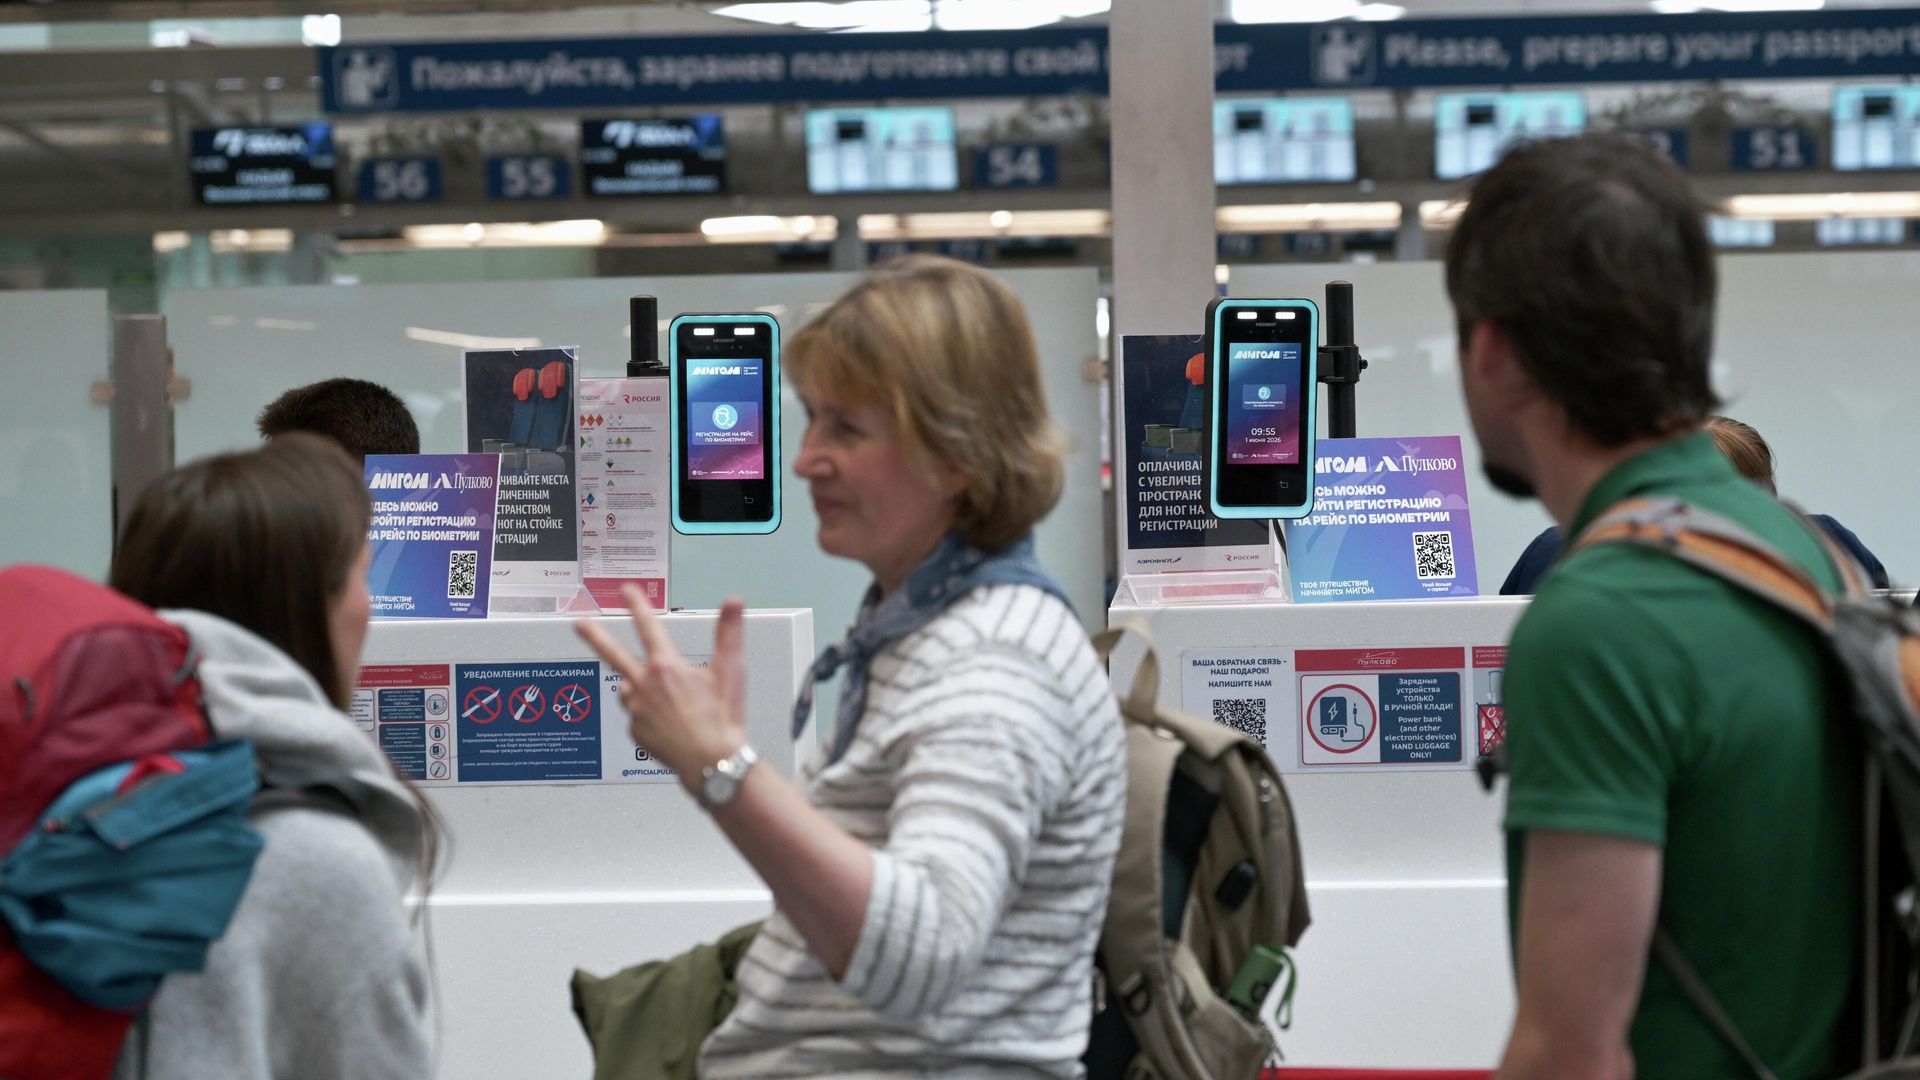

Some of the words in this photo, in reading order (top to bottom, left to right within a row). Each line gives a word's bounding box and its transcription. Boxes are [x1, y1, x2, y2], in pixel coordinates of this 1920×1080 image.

[1384, 33, 1511, 70] Please,
[1522, 35, 1669, 71] prepare
[1671, 32, 1759, 70] your
[411, 52, 634, 94] Пожалуйста,
[640, 54, 784, 90] заранее
[791, 47, 1008, 84] подготовьте
[1013, 41, 1096, 76] свой
[1751, 127, 1802, 169] 51
[988, 147, 1042, 185] 54
[373, 159, 428, 198] 56
[502, 158, 556, 197] 55
[1233, 350, 1280, 359] МИГОМ
[691, 366, 741, 375] МИГОМ
[1251, 427, 1276, 436] 09:55
[1138, 460, 1202, 472] ОПЛАЧИВА
[1315, 456, 1367, 473] ИГОМ
[1402, 455, 1457, 476] Пулково
[368, 472, 429, 489] МИГОМ
[454, 473, 493, 493] Пулково
[499, 473, 540, 485] ЧИВАЙТЕ
[541, 475, 569, 485] МЕСТА
[1138, 476, 1146, 487] С
[1333, 485, 1386, 496] МОЖНО
[371, 501, 399, 513] ДЕСЬ
[400, 501, 439, 512] МОЖНО
[496, 504, 551, 514] СТРАНСТВОМ
[1313, 498, 1344, 511] ЙТИ
[1345, 497, 1441, 511] РЕГИСТРАЦИЮ
[1139, 506, 1162, 518] ДЛЯ
[1165, 505, 1187, 516] НОГ
[1189, 505, 1205, 515] НА
[406, 515, 476, 528] РЕГИСТРАЦИЮ
[497, 519, 514, 529] НОГ
[516, 519, 528, 529] НА
[529, 516, 563, 529] СТОЙКЕ
[1313, 512, 1347, 525] РЕЙС
[1348, 514, 1367, 525] ПО
[1368, 512, 1450, 524] БИОМЕТРИИ
[1140, 519, 1218, 531] РЕГИСТРАЦИИ
[380, 528, 406, 540] РЕЙС
[407, 530, 420, 540] ПО
[421, 530, 480, 541] БИОМЕТРИИ
[495, 534, 538, 545] ИСТРАЦИИ
[1319, 580, 1368, 588] путешествие
[1300, 588, 1343, 596] начинается
[1345, 586, 1375, 595] МИГОМ
[393, 602, 415, 610] МИГОМ
[1192, 659, 1215, 667] ВАША
[1216, 658, 1256, 666] ОБРАТНАЯ
[464, 670, 530, 679] УВЕДОМЛЕНИЕ
[531, 669, 594, 678] ПАССАЖИРАМ
[1230, 667, 1269, 676] ПОДАРОК!
[1208, 680, 1252, 688] НАПИШИТЕ
[1399, 678, 1438, 686] Зарядные
[1396, 686, 1440, 695] устройства
[1391, 703, 1422, 711] РУЧНОЙ
[1424, 703, 1453, 711] КЛАДИ!
[1400, 725, 1417, 733] (and
[1425, 733, 1456, 741] devices)
[1410, 751, 1432, 759] ONLY!
